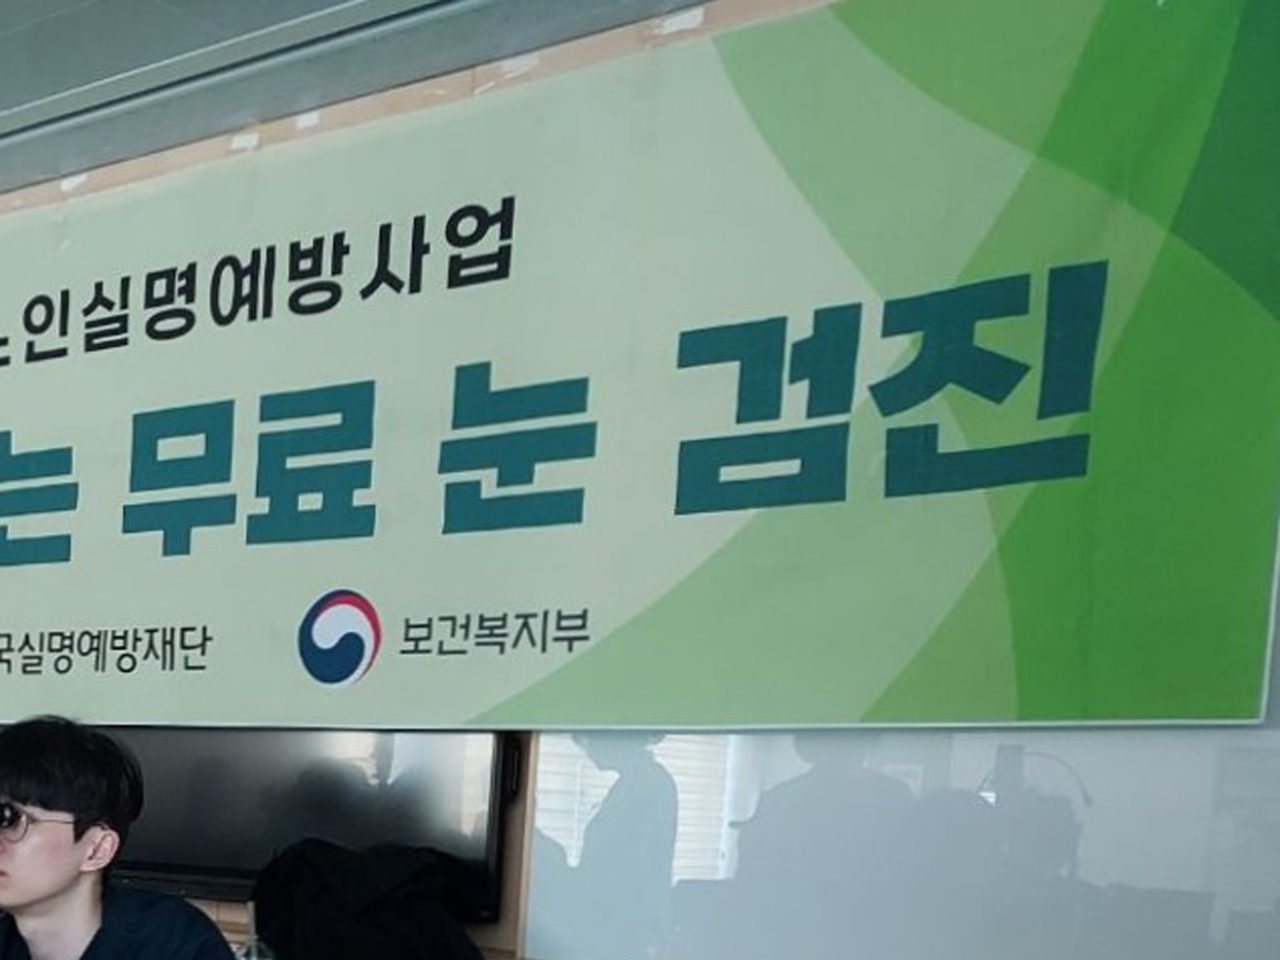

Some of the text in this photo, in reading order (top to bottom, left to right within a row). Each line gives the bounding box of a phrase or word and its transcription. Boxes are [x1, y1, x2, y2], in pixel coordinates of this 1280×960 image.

[121, 380, 377, 556] 무료
[437, 362, 597, 534] 눈
[674, 260, 1110, 515] 검진
[399, 607, 591, 656] 보건복지부
